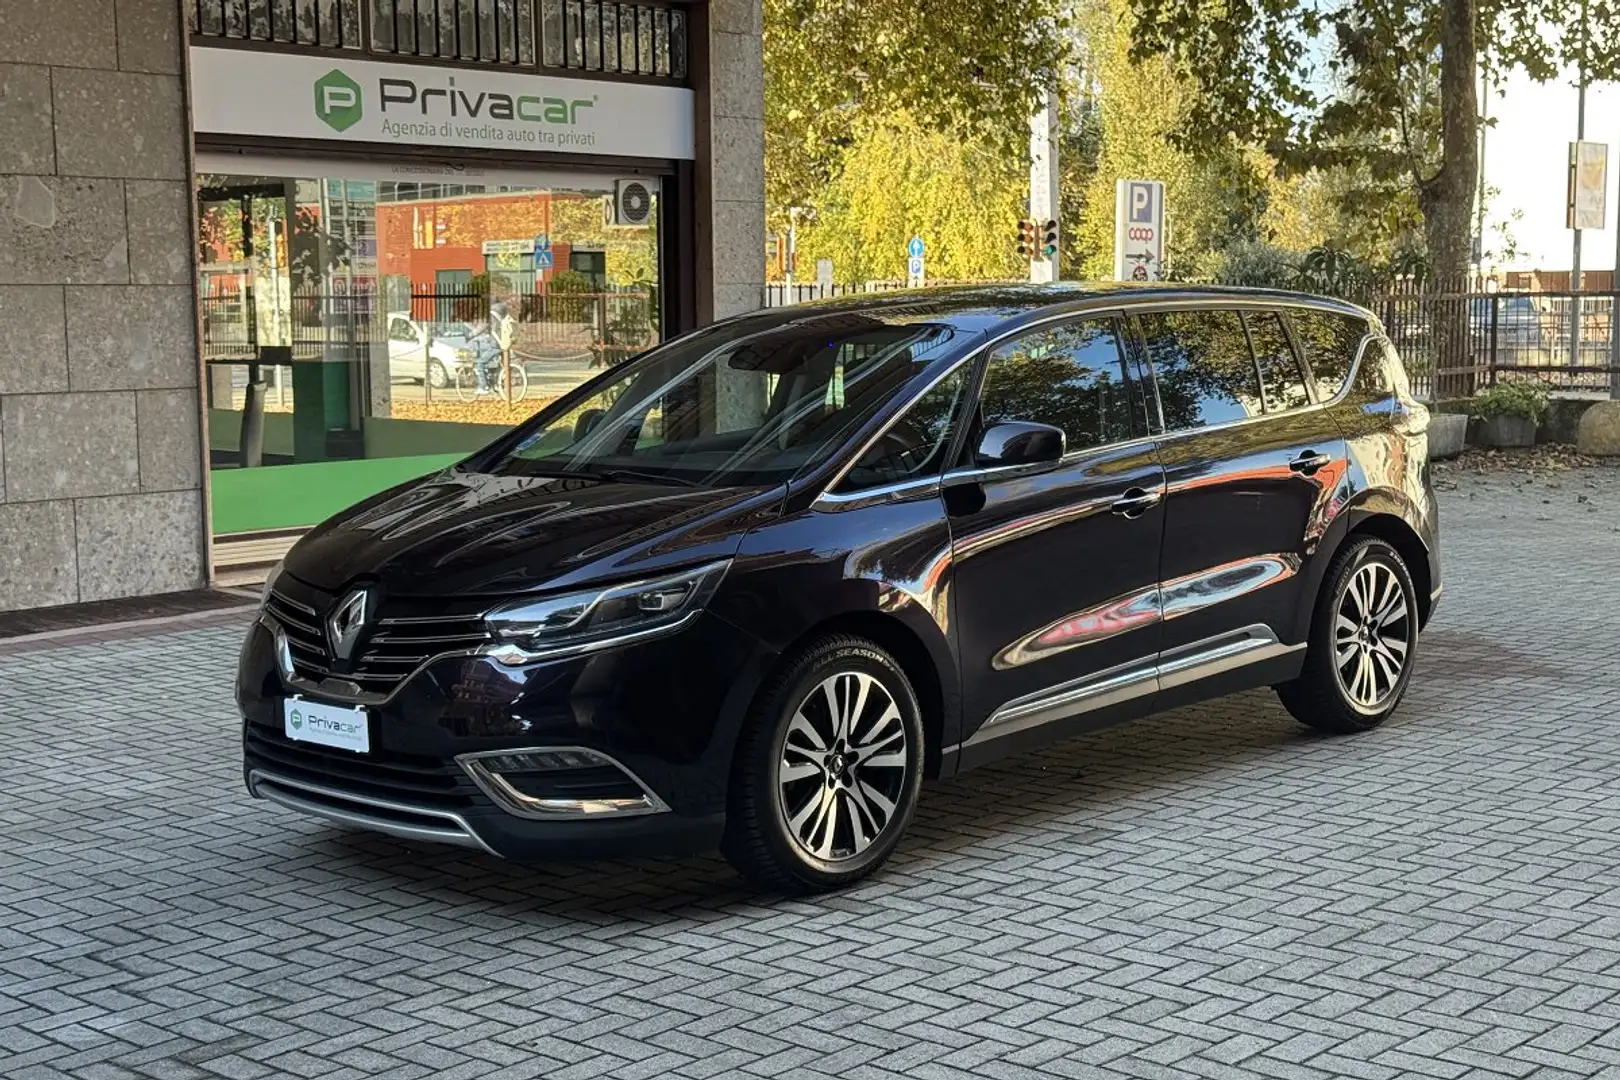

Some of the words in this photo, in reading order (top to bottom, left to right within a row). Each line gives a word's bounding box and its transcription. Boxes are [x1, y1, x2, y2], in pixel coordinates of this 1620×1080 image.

[379, 76, 594, 125] Privacar
[381, 118, 436, 138] Agenzia
[440, 122, 452, 137] di
[455, 124, 503, 141] vendita
[507, 129, 535, 142] auto
[538, 130, 555, 143] tra
[558, 131, 596, 147] privati
[1132, 186, 1149, 220] P
[836, 647, 884, 663] SEASON
[308, 714, 361, 734] Privacar
